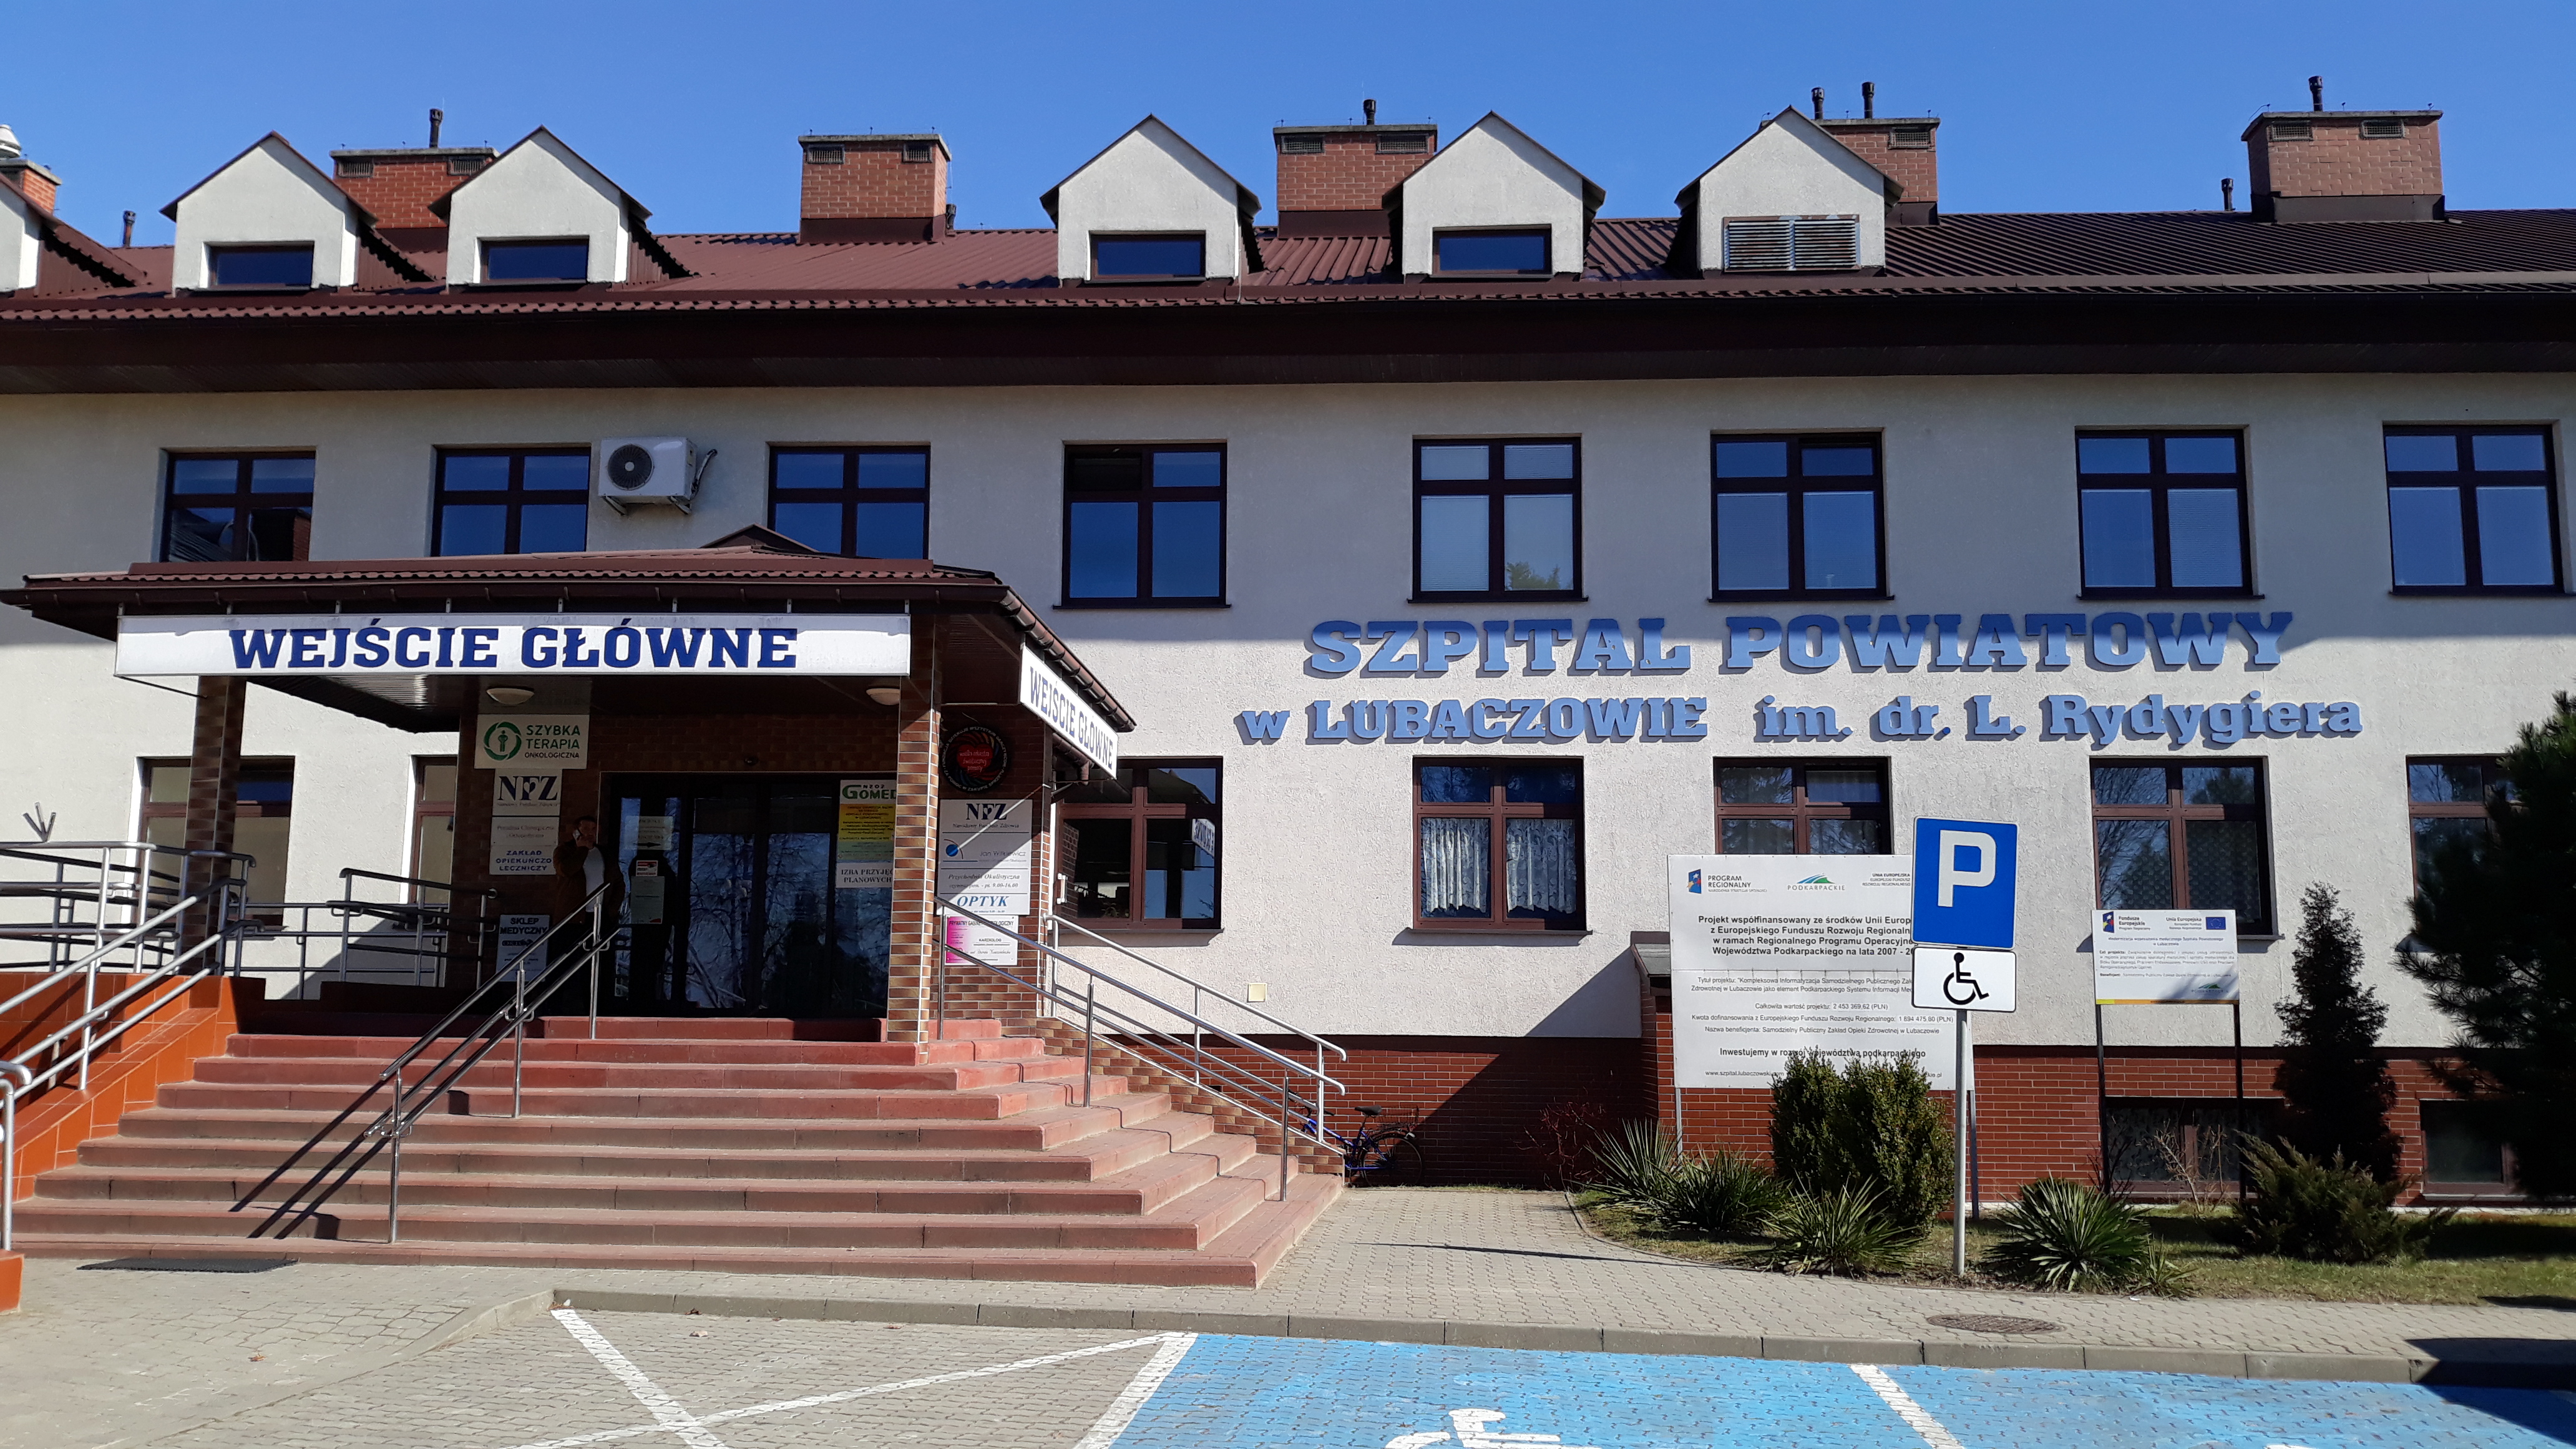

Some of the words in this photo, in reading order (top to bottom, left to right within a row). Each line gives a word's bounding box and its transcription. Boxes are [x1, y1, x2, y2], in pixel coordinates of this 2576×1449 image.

[228, 618, 500, 670] WEJŚCIE
[520, 618, 798, 670] GŁÓWNE
[1309, 618, 1692, 674] SZPITAL
[1725, 612, 2294, 670] POWIATOWY
[1241, 710, 1290, 739] w
[1312, 696, 1708, 740] LUBACZOWIE
[1759, 694, 1853, 738] im.
[1878, 694, 1952, 738] dr.
[1971, 694, 2026, 735] L.
[2046, 690, 2363, 750] Rydygiera
[526, 724, 580, 736] SZYBKA
[526, 738, 580, 749] TERAPIA
[497, 776, 558, 801] NFZ
[842, 784, 897, 799] GOMED
[965, 803, 1008, 820] NFZ
[1938, 829, 1997, 907] P
[957, 895, 1010, 907] OPTYK
[1698, 916, 1730, 924] Projekt
[1731, 915, 1811, 925] współfinansowany
[1825, 915, 1863, 924] środków
[1865, 916, 1882, 924] Unii
[1885, 917, 1911, 925] Europ
[500, 927, 548, 935] MEDYCZNY
[1717, 926, 1779, 935] Europejskiego
[1782, 926, 1825, 934] Funduszu
[1827, 927, 1864, 935] Rozwoju
[1866, 926, 1911, 936] Regionaln
[1757, 937, 1817, 946] Regionalnego
[1819, 937, 1861, 946] Programu
[1712, 947, 1772, 956] Województwa
[1774, 947, 1844, 957] Podkarpackiego
[1859, 947, 1875, 956] lata
[1877, 948, 1898, 956] 2007
[1720, 1047, 1769, 1058] Inwestujemy
[1863, 1048, 1926, 1059] podkarpackiego
